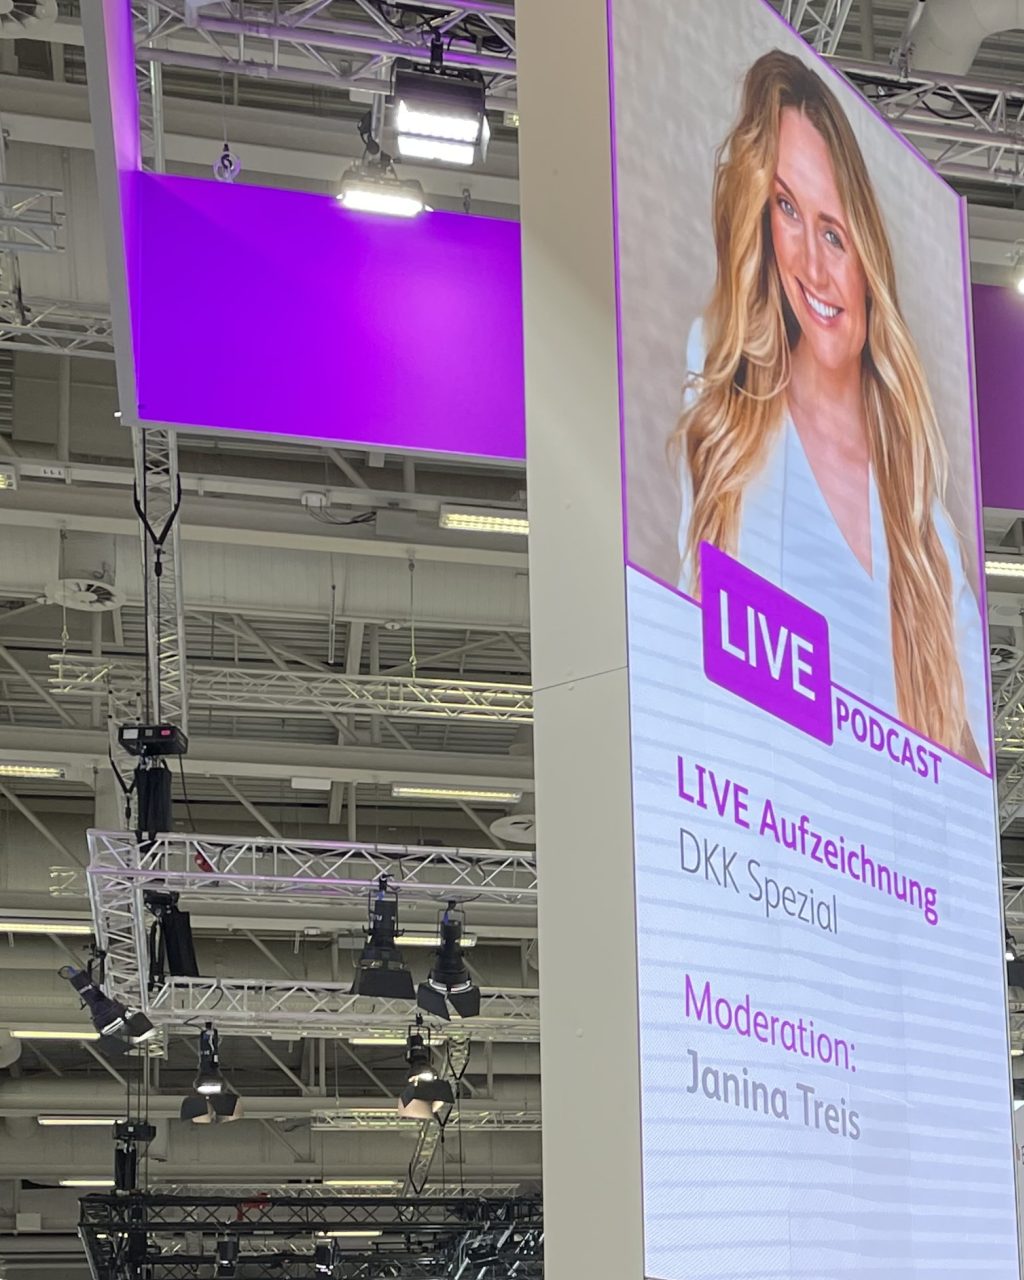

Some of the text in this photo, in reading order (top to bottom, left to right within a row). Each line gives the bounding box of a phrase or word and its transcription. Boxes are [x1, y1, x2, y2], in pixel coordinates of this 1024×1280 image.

[719, 589, 816, 702] LIVE
[836, 697, 942, 784] PODCAST
[677, 756, 939, 926] LIVE Aufzeichnung
[680, 827, 838, 935] DKK Spezial
[685, 973, 856, 1072] Moderation:
[686, 1048, 861, 1140] Janina Treis
